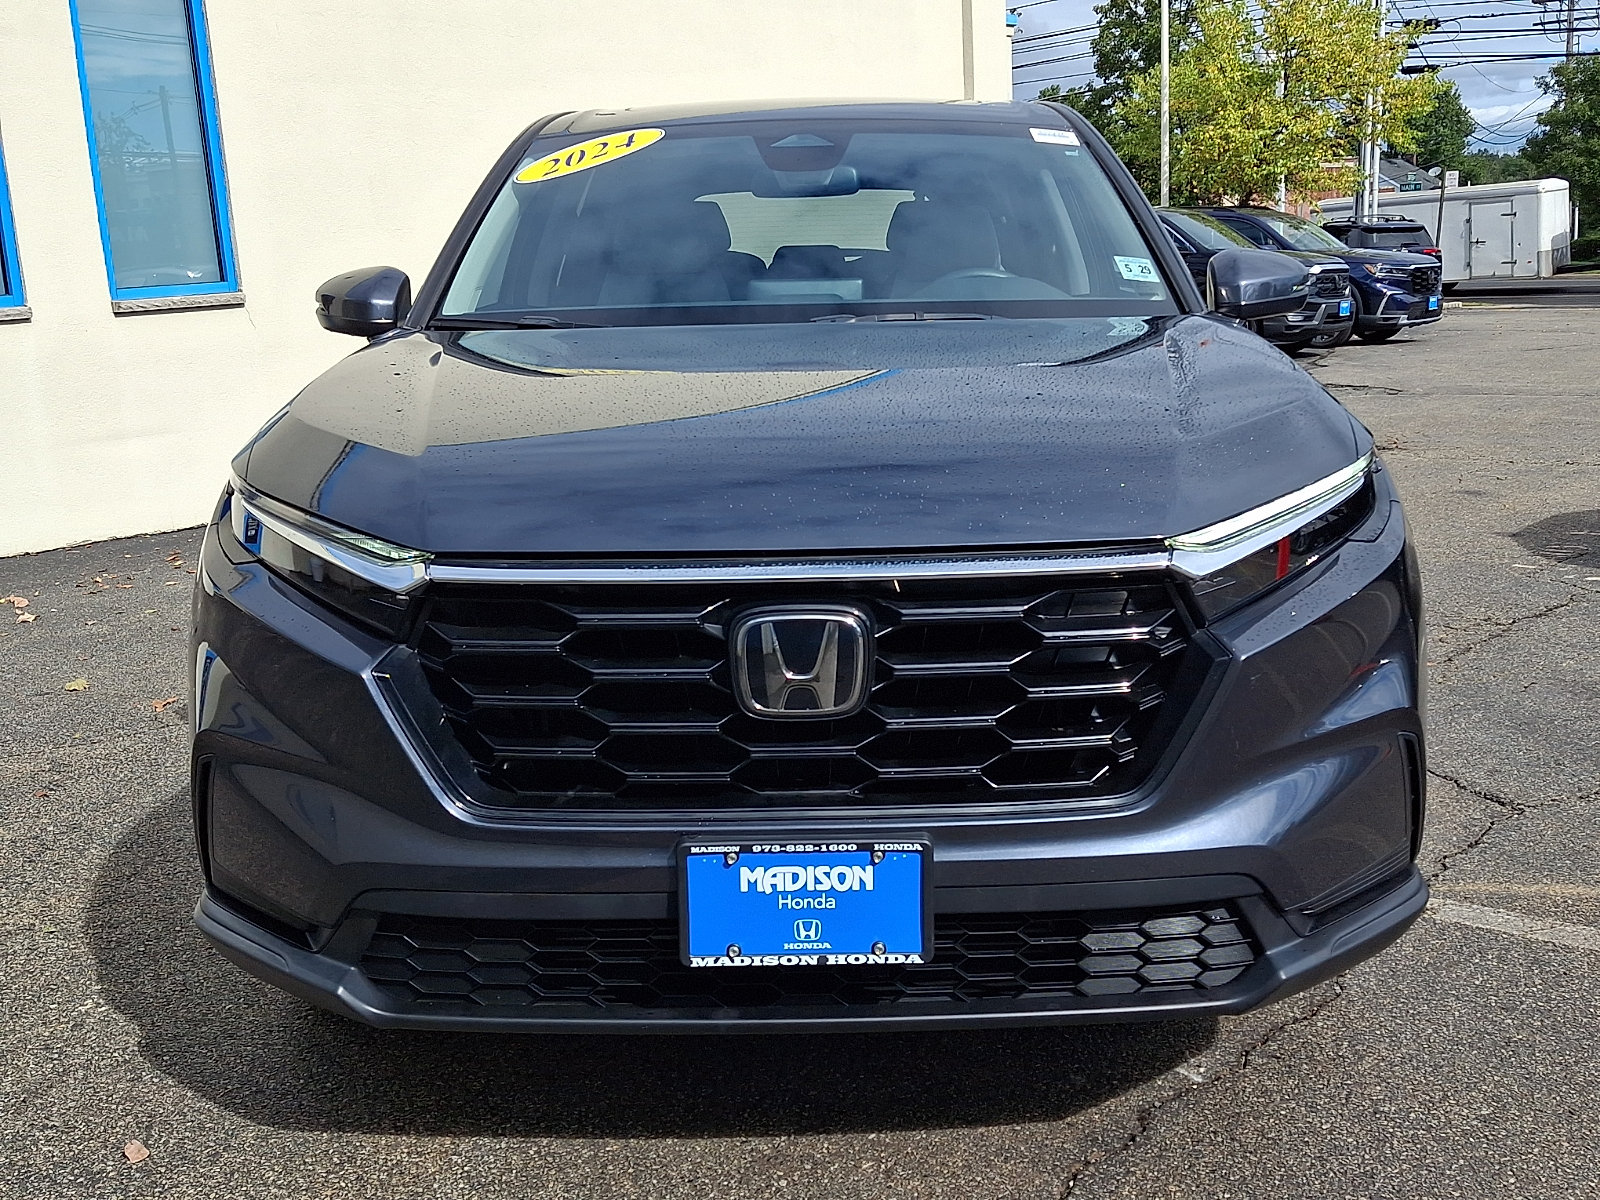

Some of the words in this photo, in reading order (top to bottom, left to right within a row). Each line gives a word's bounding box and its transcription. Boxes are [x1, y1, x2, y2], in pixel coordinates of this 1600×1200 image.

[542, 132, 636, 177] 2024
[1124, 263, 1133, 273] 5
[1137, 264, 1152, 275] 29
[690, 845, 741, 853] MADISON
[752, 844, 858, 853] 973-822-1600
[873, 843, 924, 851] HONDA
[739, 865, 874, 895] MADISON
[778, 893, 836, 910] Honda
[783, 942, 832, 950] HONDA
[690, 955, 820, 968] MADISON
[825, 953, 925, 965] HONDA
